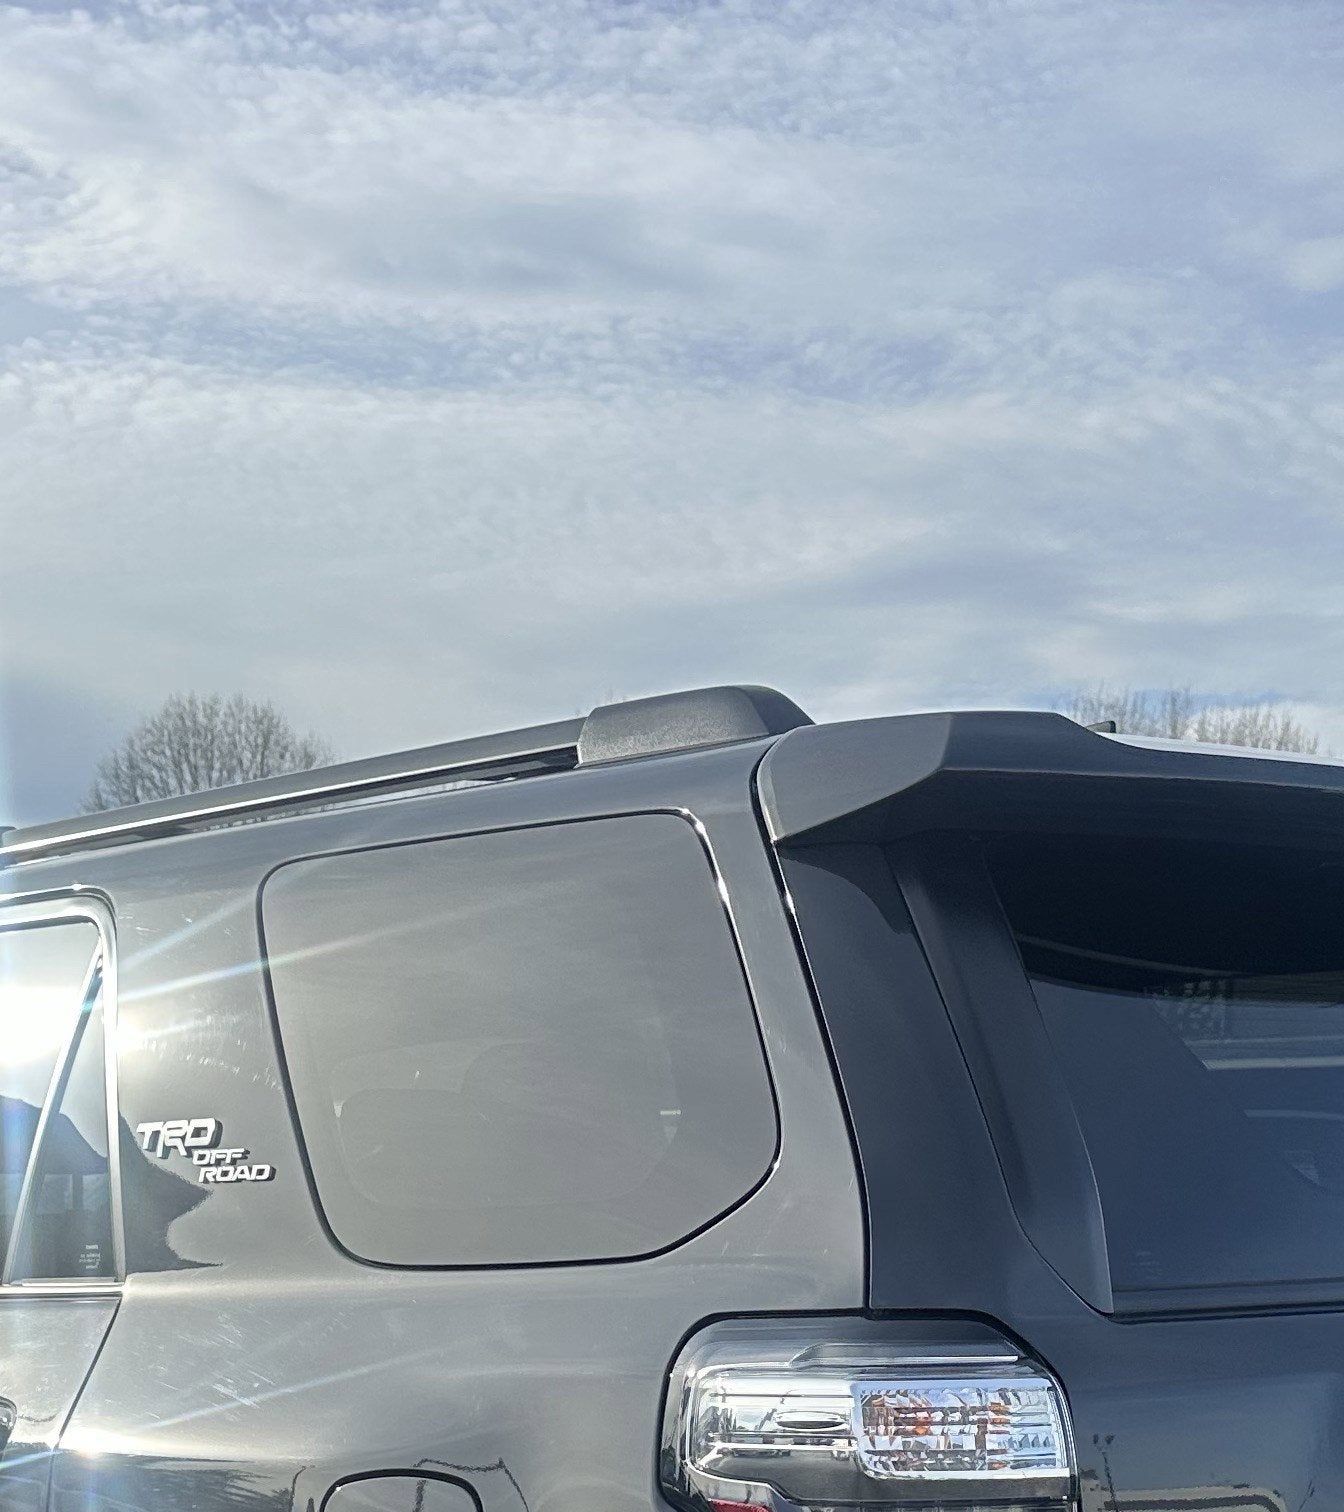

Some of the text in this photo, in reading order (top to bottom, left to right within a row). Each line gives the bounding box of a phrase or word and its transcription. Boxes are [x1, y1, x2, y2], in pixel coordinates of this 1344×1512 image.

[136, 1117, 218, 1160] TRD
[192, 1147, 246, 1166] OFF
[198, 1164, 272, 1183] ROAD
